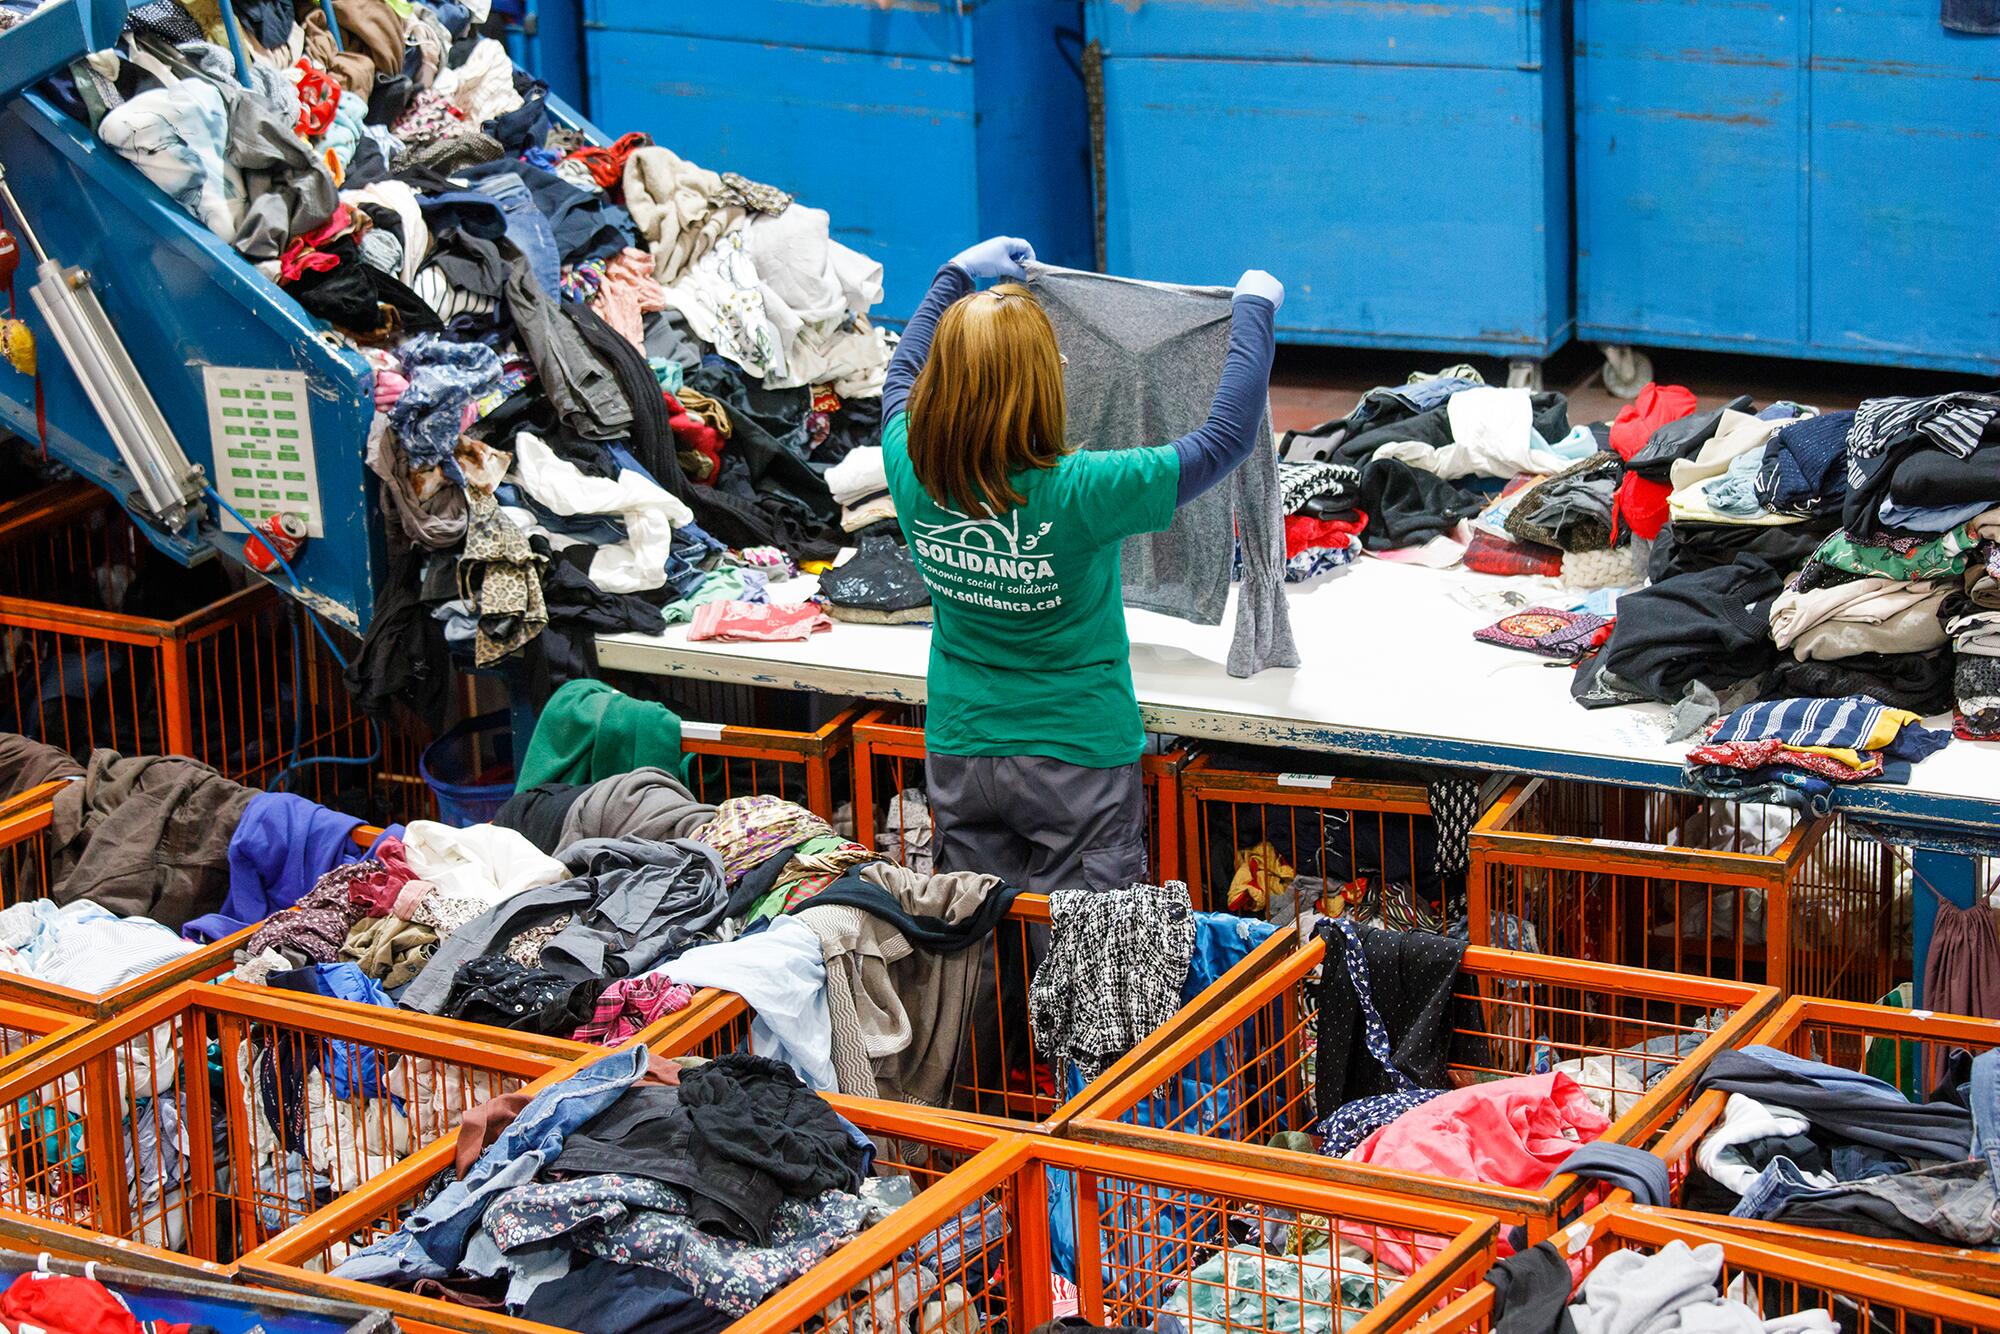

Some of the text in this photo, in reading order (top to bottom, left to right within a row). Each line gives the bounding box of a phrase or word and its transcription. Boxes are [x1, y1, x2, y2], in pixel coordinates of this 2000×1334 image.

[914, 538, 1055, 585] SOLIDANÇA
[922, 572, 1063, 613] www.solidanca.cat
[967, 577, 997, 591] social
[1007, 582, 1059, 595] solidària
